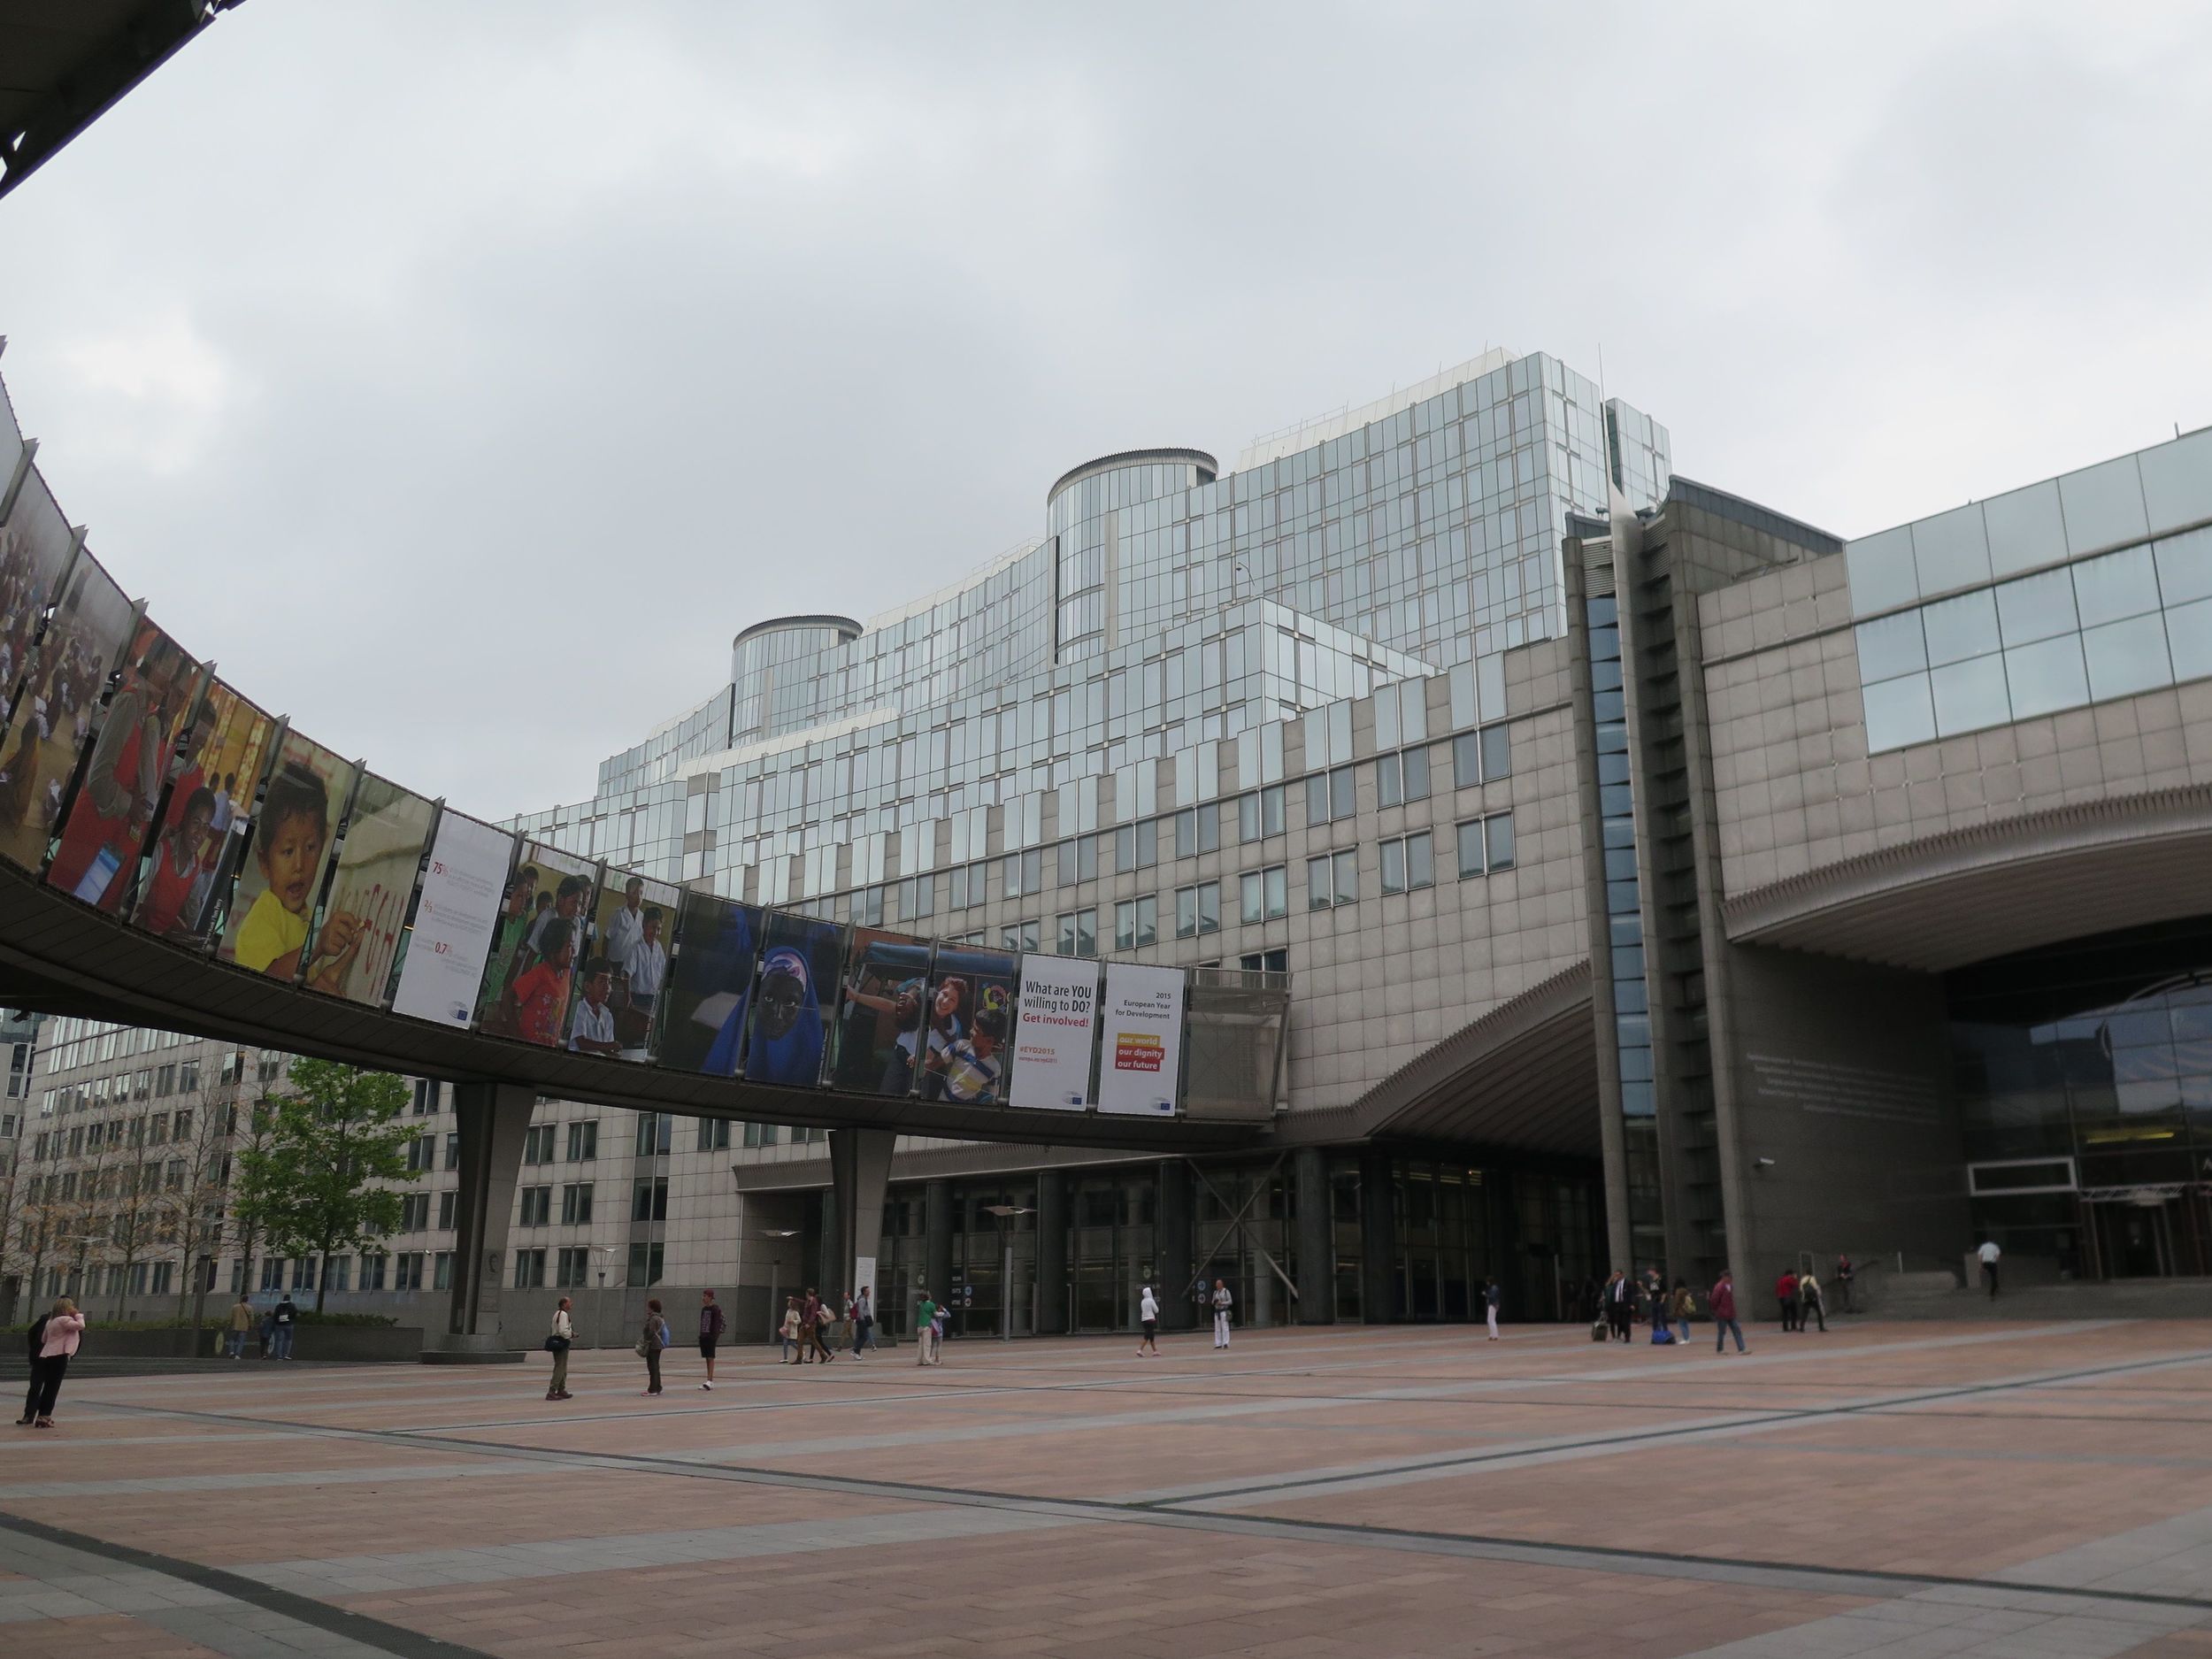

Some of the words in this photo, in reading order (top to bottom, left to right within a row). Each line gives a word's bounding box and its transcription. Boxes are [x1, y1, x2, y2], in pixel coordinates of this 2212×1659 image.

[433, 862, 449, 878] 75%
[434, 941, 453, 956] 0.7%
[1025, 980, 1052, 995] What
[1054, 986, 1070, 997] are
[1071, 985, 1092, 999] YOU
[1024, 996, 1057, 1013] willing
[1060, 1000, 1070, 1011] to
[1071, 1000, 1091, 1013] DO?
[1124, 1000, 1156, 1009] European
[1023, 1012, 1041, 1023] Get
[1042, 1014, 1089, 1027] involved!
[1126, 1010, 1170, 1019] Development
[1019, 1046, 1056, 1056] #EYD2015
[1133, 1048, 1163, 1059] dignity
[1133, 1060, 1158, 1070] future
